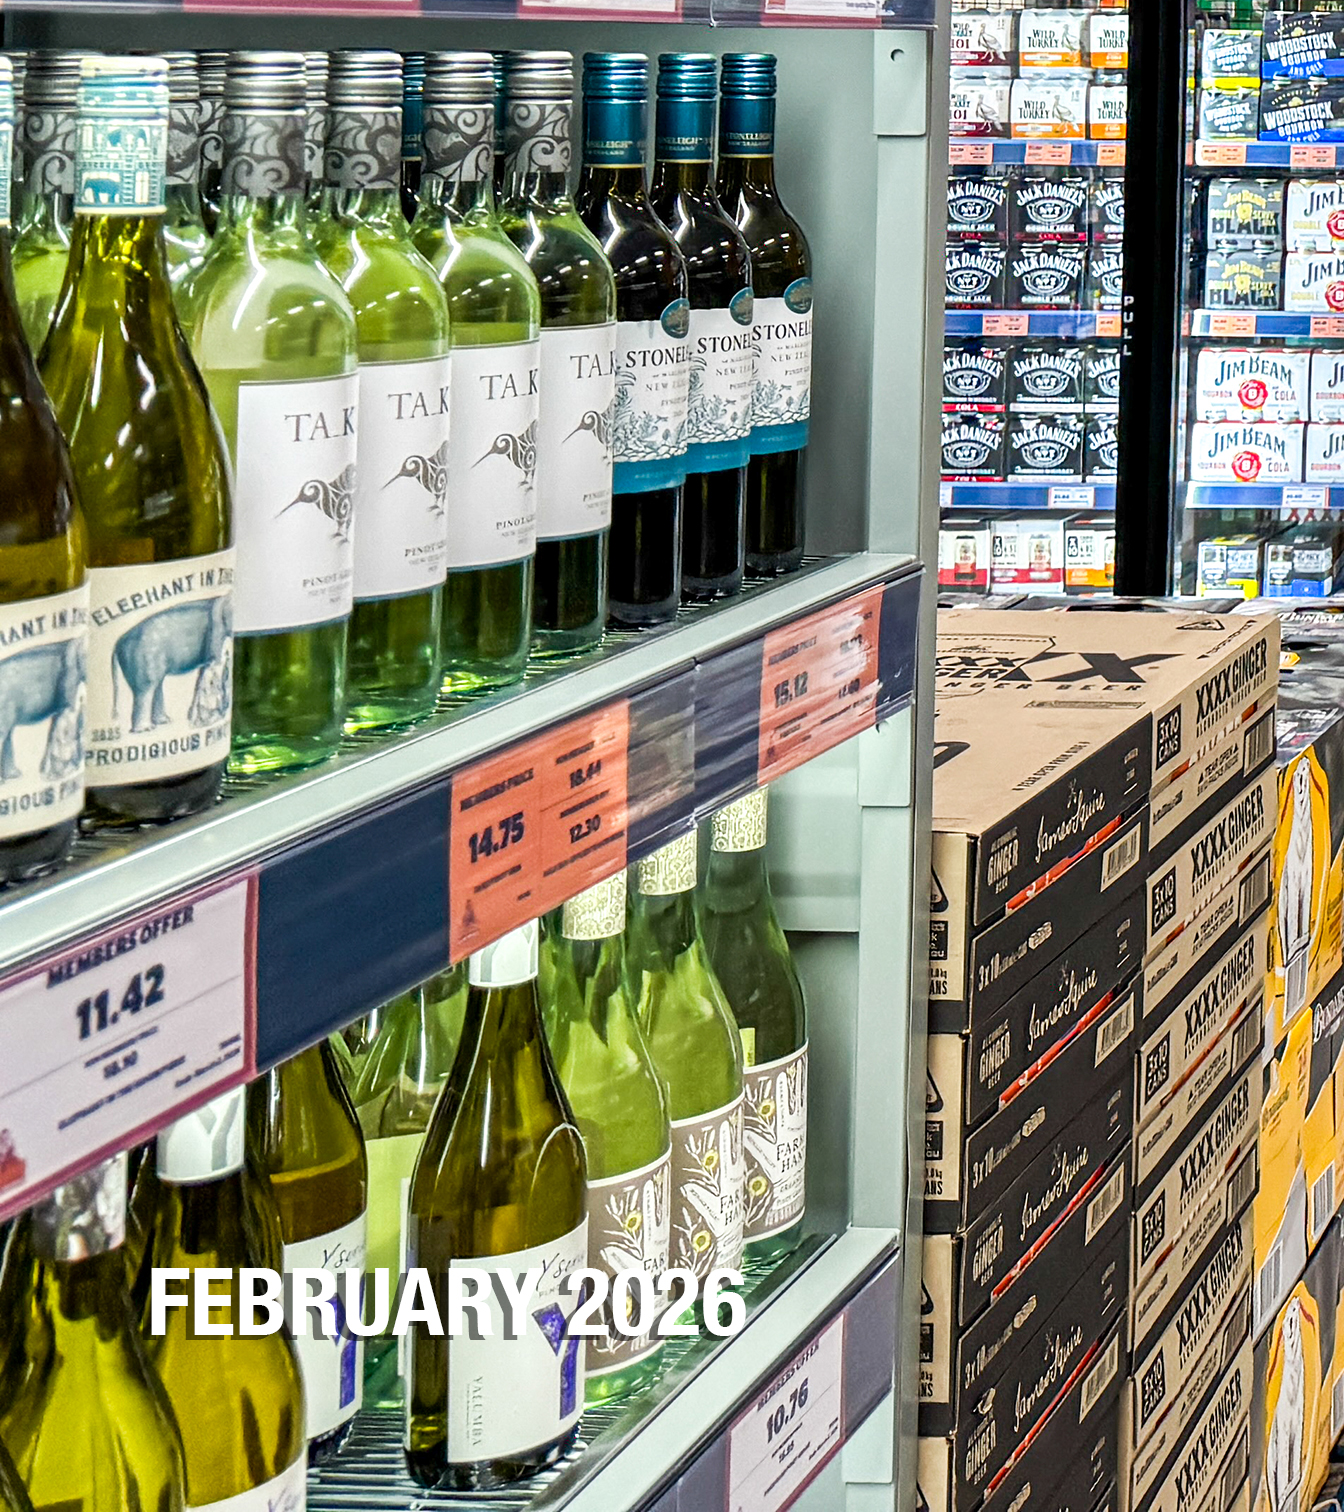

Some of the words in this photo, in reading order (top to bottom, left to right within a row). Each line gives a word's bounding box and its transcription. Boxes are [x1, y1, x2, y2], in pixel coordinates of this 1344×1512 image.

[1028, 36, 1060, 49] TURKEY
[1032, 28, 1056, 40] WILD
[1265, 31, 1337, 61] WOODSTOCK
[1280, 49, 1328, 67] BOURBON
[1018, 108, 1050, 120] TURKEY
[1023, 99, 1046, 112] WILD
[1263, 100, 1335, 132] WOODSTOCK
[1016, 181, 1043, 206] JACK
[1043, 180, 1085, 206] DANIEL'S
[1304, 188, 1335, 218] JIM
[1302, 260, 1332, 289] JIM
[1123, 295, 1135, 357] PULL
[1215, 359, 1246, 386] JIM
[1248, 356, 1293, 387] BEAM
[1274, 390, 1297, 401] COLA
[91, 573, 195, 628] ELEPHANT
[200, 568, 216, 587] IN
[1056, 684, 1143, 692] BEER
[1195, 666, 1231, 725] XXXX
[1231, 637, 1269, 686] GINGER
[85, 733, 200, 768] PRODIGIOUS
[468, 810, 526, 864] 14.75
[986, 837, 1020, 888] GINGER
[46, 928, 136, 990] MEMBERS
[139, 904, 195, 945] OFFER
[75, 962, 166, 1042] 11.42
[766, 1376, 809, 1445] 10.76
